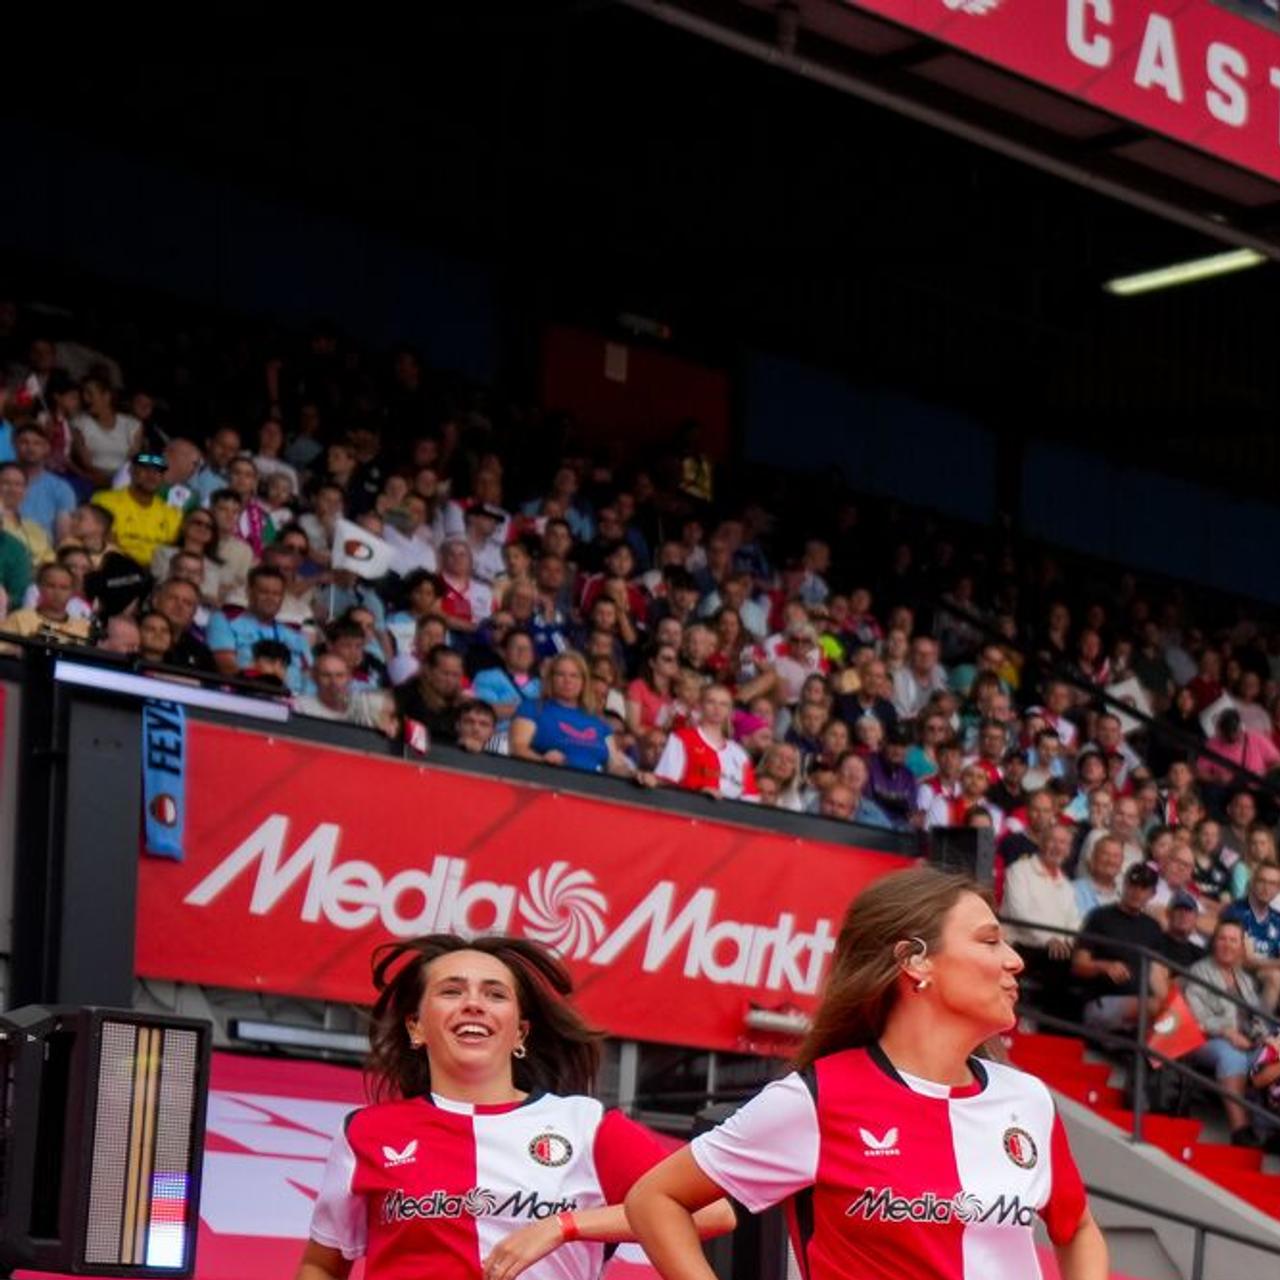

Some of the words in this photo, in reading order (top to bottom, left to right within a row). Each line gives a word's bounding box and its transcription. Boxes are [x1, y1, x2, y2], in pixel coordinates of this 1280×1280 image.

[182, 813, 516, 941] Media
[592, 880, 836, 996] Markt
[378, 1187, 464, 1225] Media
[846, 1185, 951, 1224] Media
